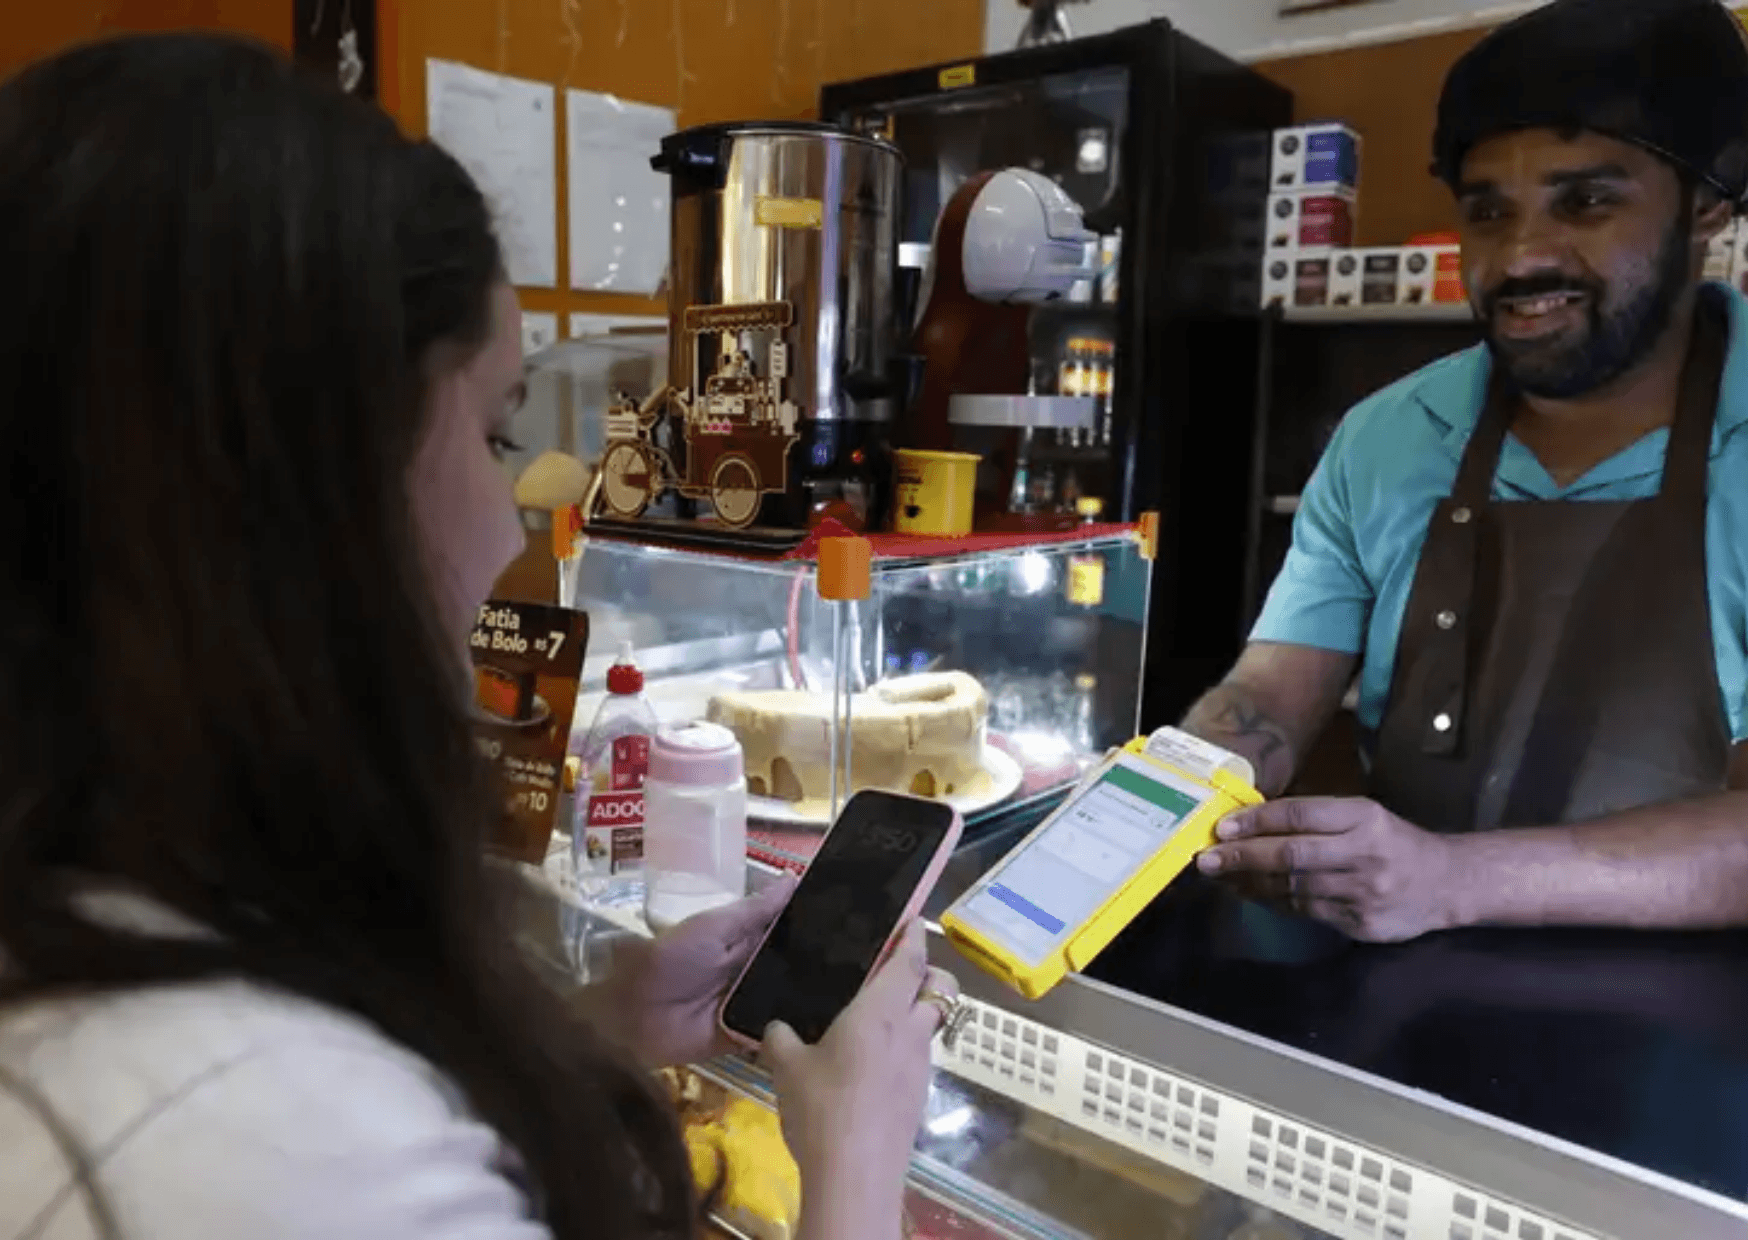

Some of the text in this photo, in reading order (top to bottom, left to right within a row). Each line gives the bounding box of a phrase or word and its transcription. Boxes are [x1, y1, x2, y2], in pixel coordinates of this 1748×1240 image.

[479, 603, 520, 630] Fatia
[470, 628, 490, 649] de
[492, 630, 528, 654] Bolo
